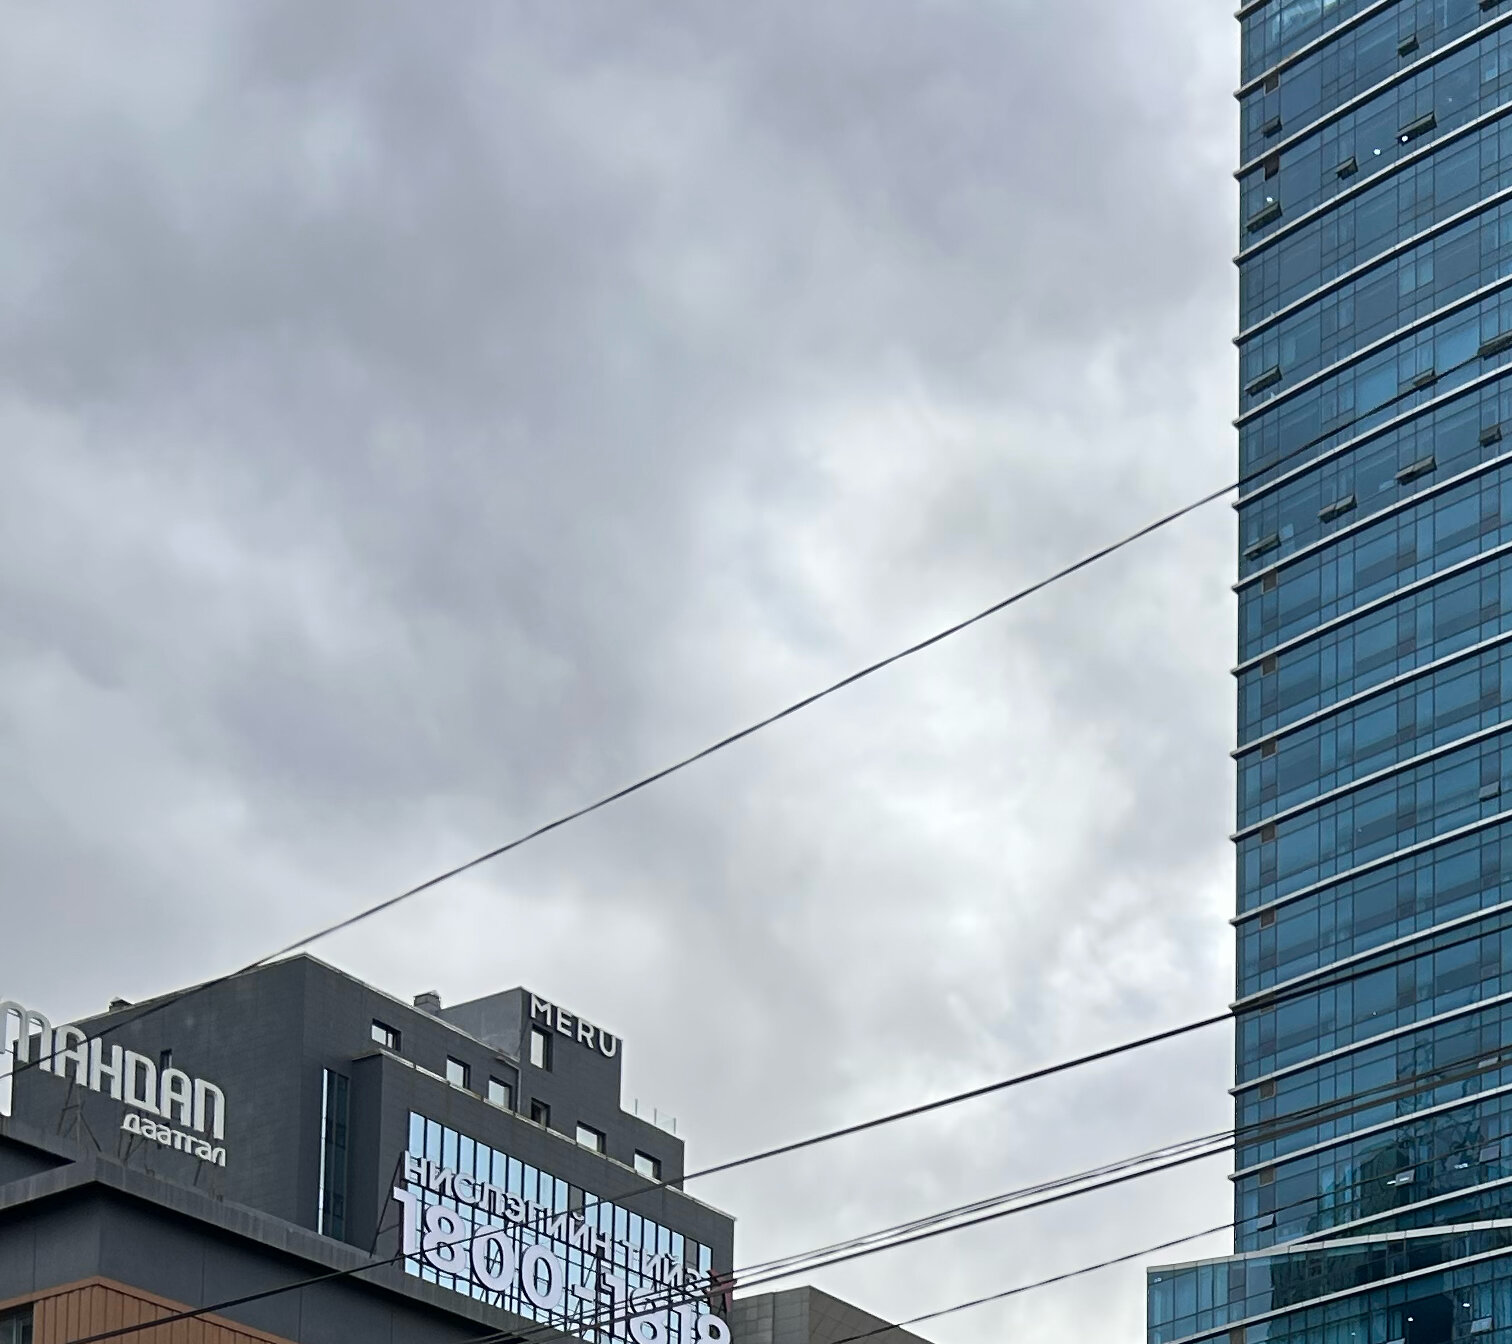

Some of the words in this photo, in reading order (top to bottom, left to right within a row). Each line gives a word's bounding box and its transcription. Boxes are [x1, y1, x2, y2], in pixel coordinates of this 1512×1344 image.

[531, 993, 617, 1057] MERU
[120, 1113, 226, 1167] даатгал
[404, 1150, 612, 1260] НИСЛЭГИЙН
